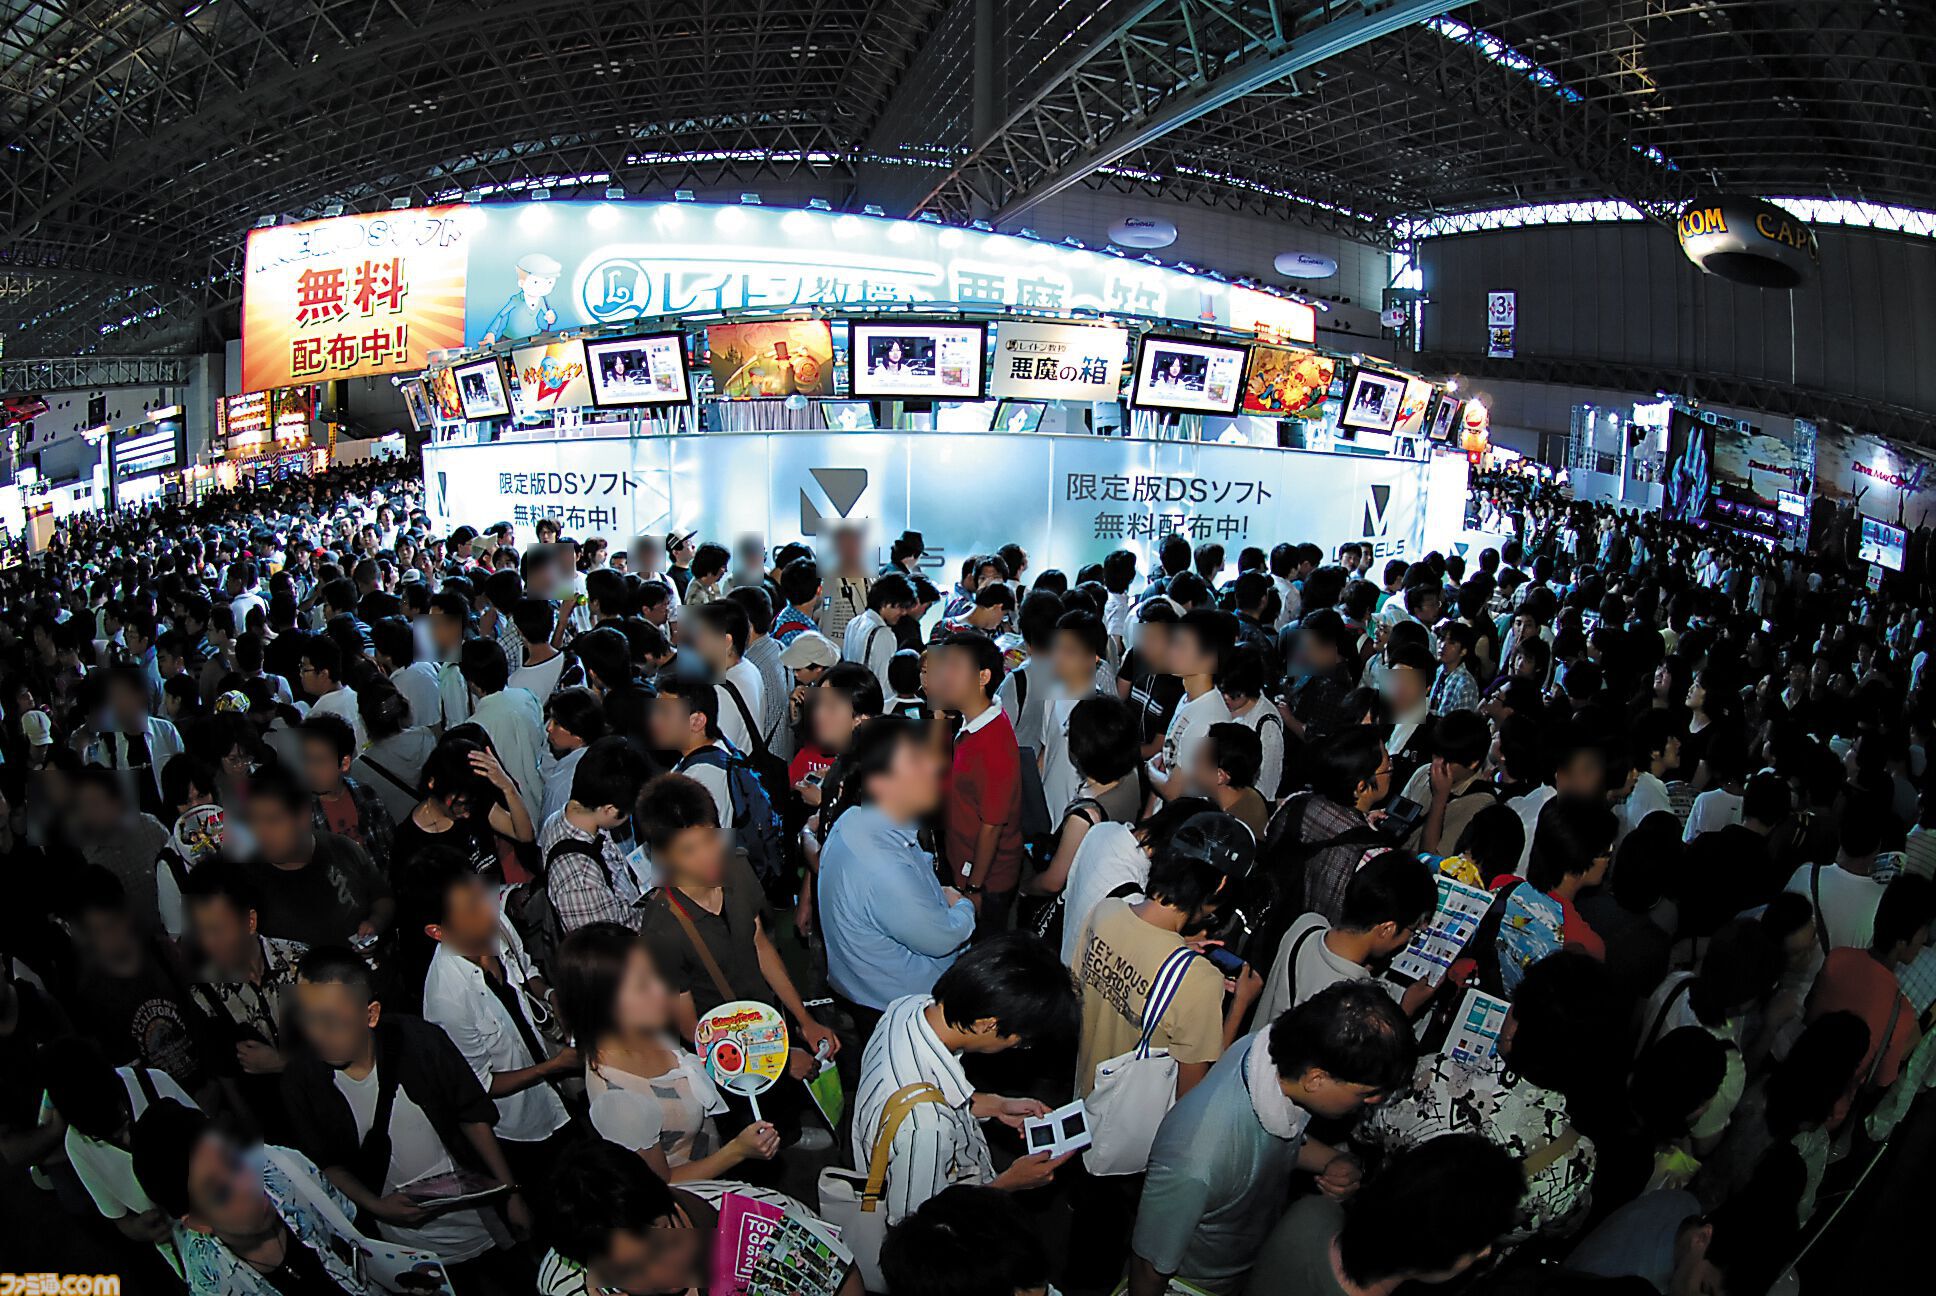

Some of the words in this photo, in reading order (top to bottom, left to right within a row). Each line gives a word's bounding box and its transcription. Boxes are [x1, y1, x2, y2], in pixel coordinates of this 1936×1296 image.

[1678, 207, 1728, 246] COM
[296, 257, 407, 325] 無料
[1496, 296, 1507, 315] 3
[291, 324, 407, 375] 配布中!
[1010, 356, 1108, 385] 悪魔の箱
[500, 471, 638, 497] 限定版DSソフト
[1066, 473, 1272, 505] 限定版DSソフト
[514, 503, 617, 531] 無料配布中!
[1094, 511, 1249, 541] 無料配布中!
[1332, 539, 1405, 563] LEL5
[1085, 948, 1130, 1000] ECORDS
[1113, 956, 1150, 1000] MOUS
